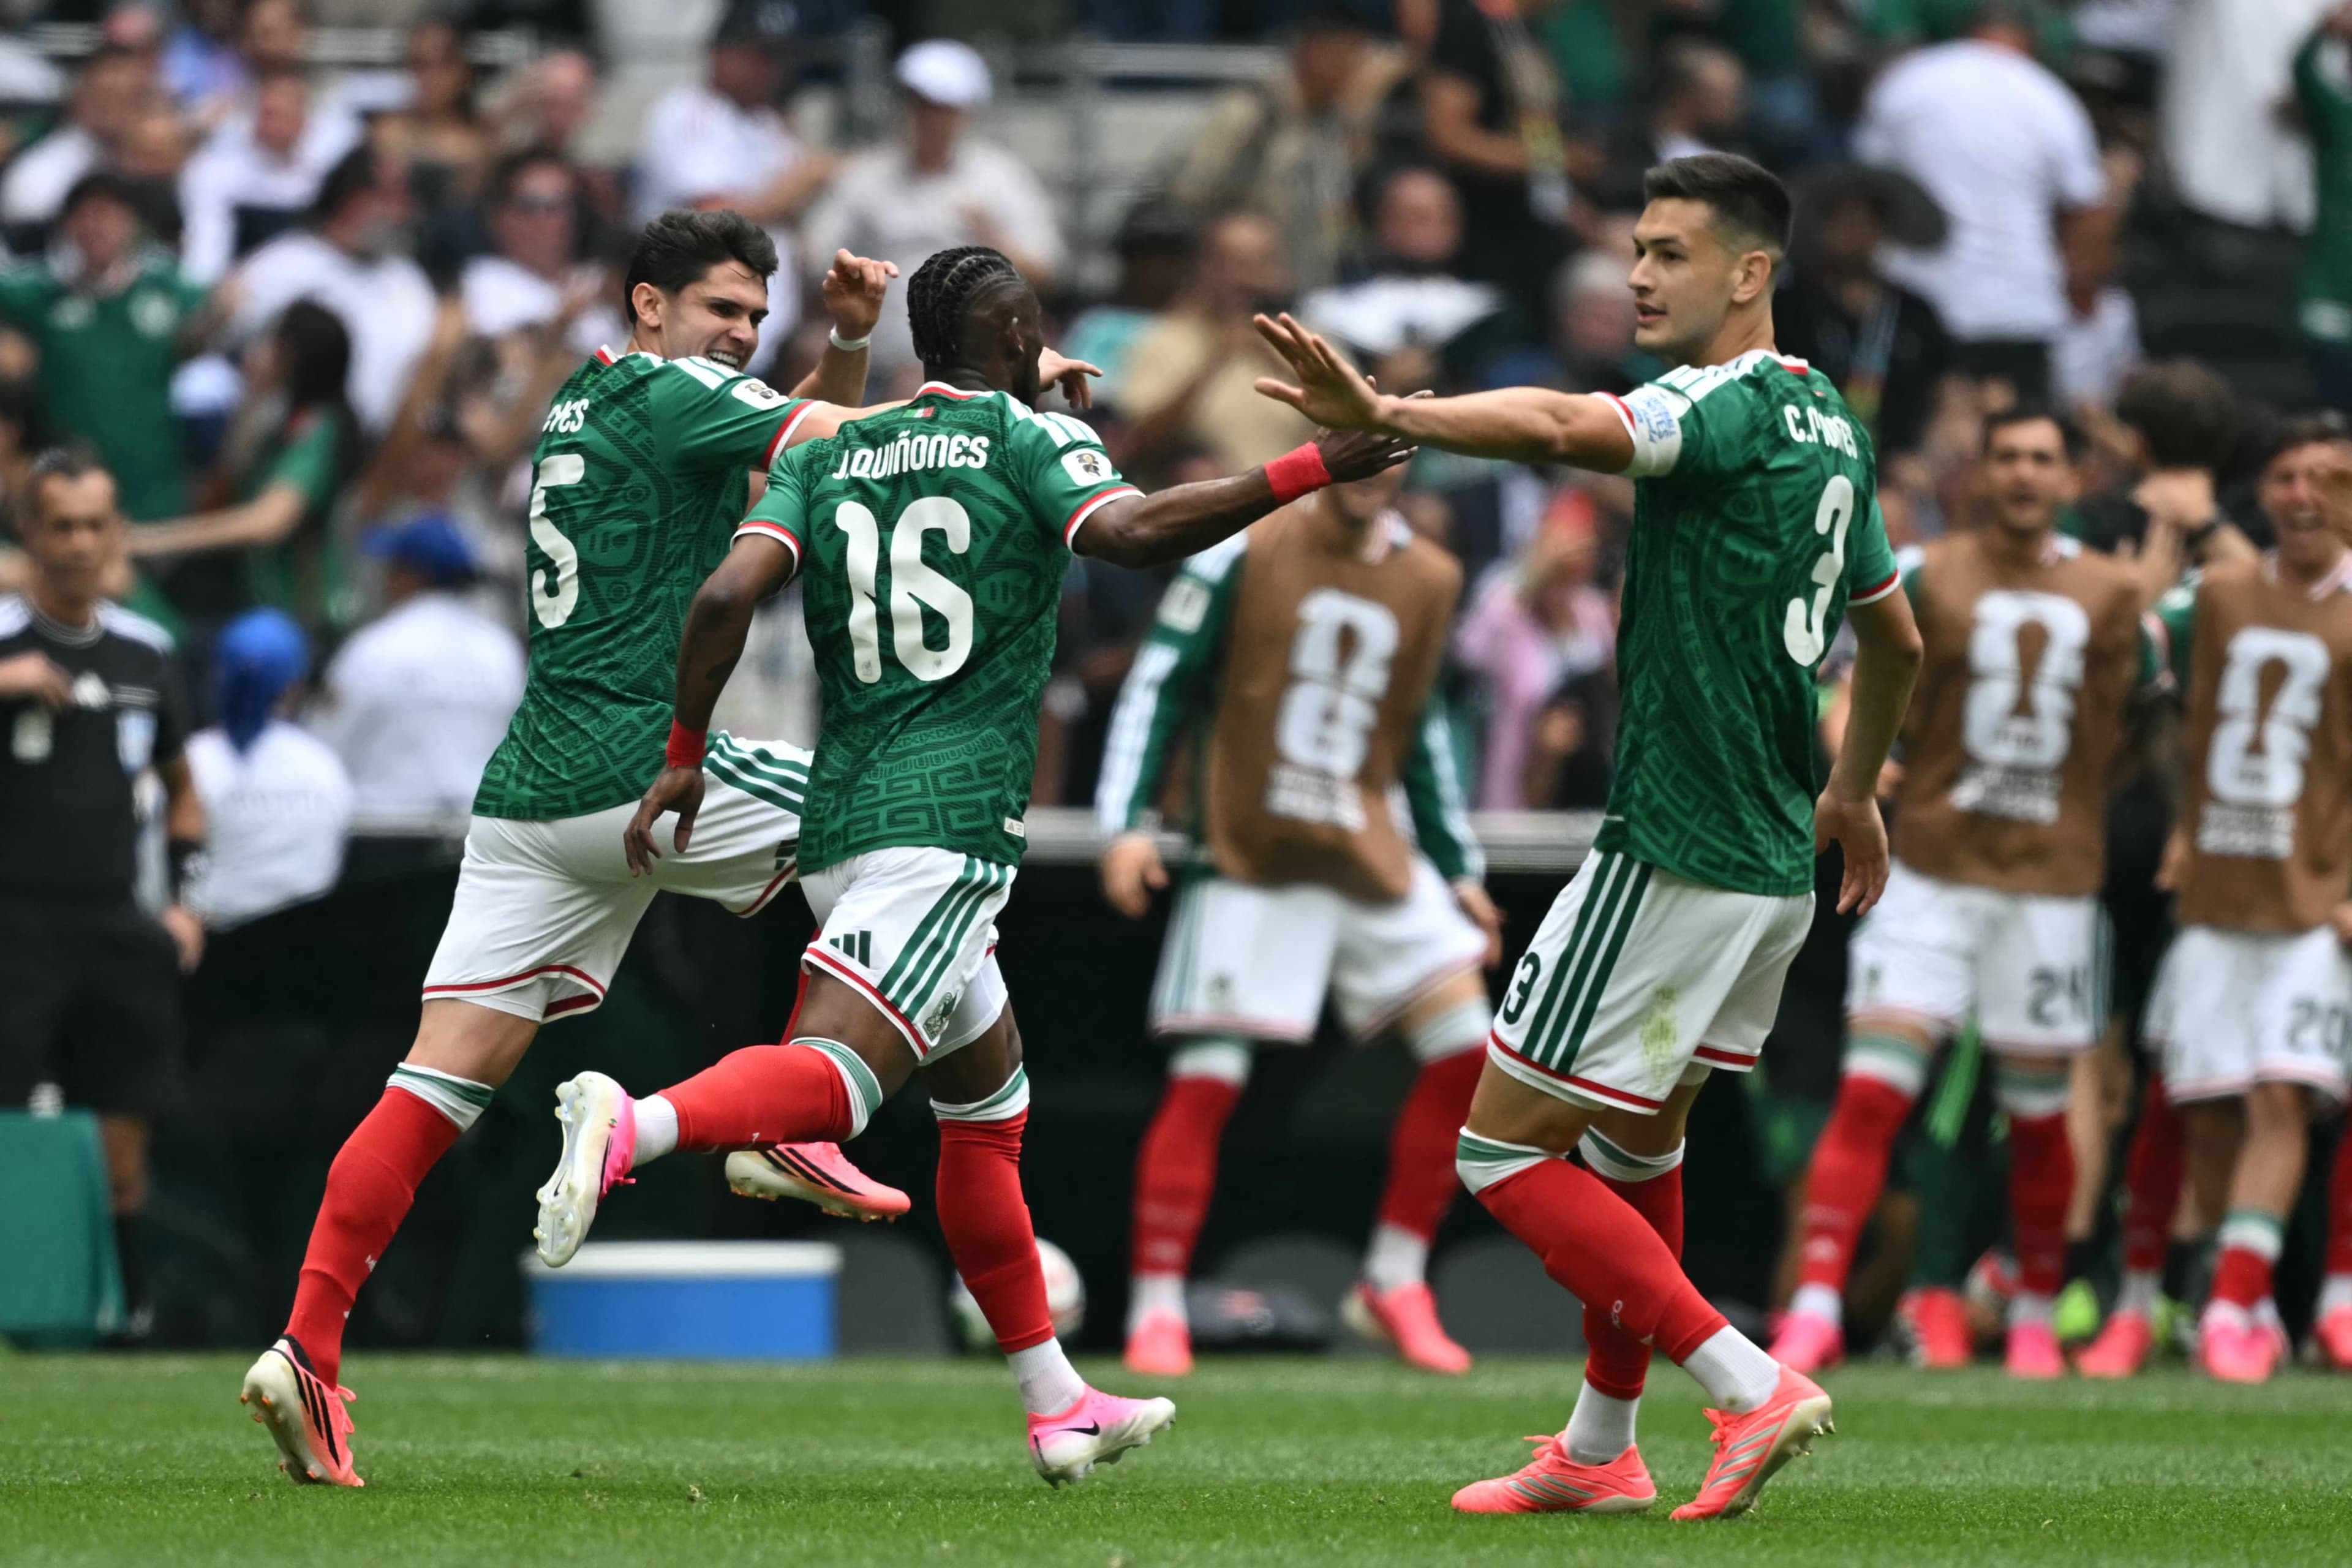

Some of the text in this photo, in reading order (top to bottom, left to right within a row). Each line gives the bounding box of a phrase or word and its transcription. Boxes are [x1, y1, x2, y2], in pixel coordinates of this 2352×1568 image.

[530, 454, 585, 629] 5
[832, 429, 990, 480] J.QUIÑONES
[835, 496, 974, 684] 16
[1784, 475, 1854, 666] 3
[1503, 951, 1541, 1025] 3
